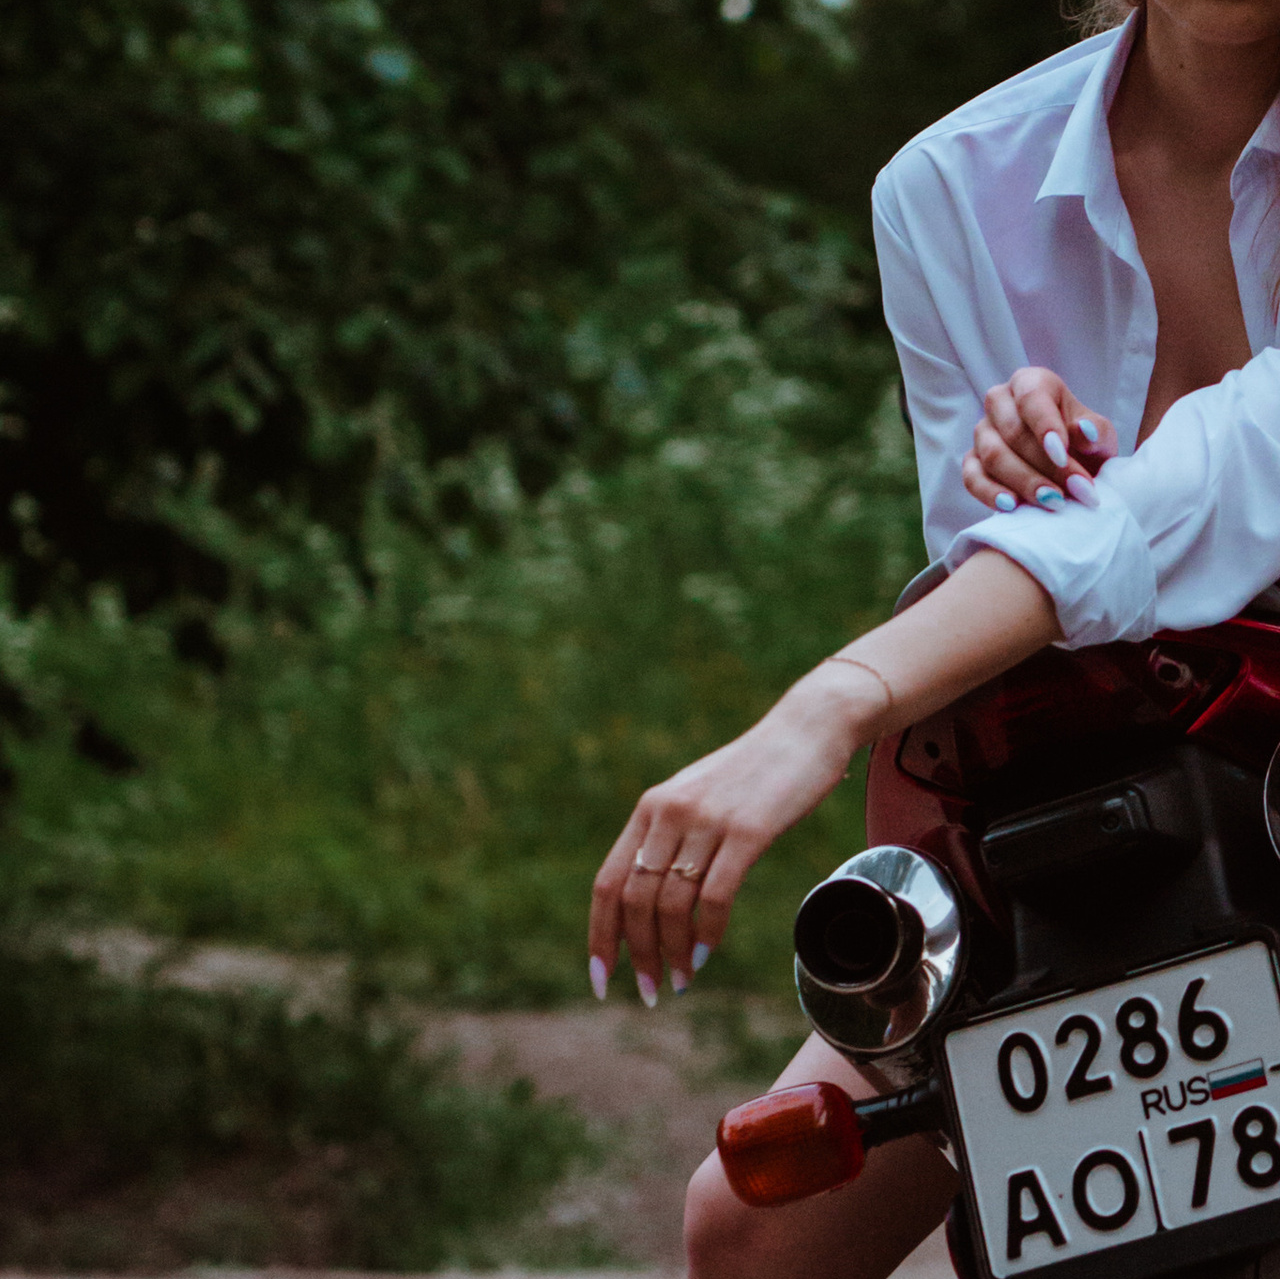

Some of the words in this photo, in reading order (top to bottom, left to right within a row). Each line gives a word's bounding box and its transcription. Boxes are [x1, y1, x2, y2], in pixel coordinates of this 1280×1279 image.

[998, 977, 1230, 1113] 0286
[1141, 1076, 1210, 1120] RUS
[1006, 1149, 1140, 1261] AO
